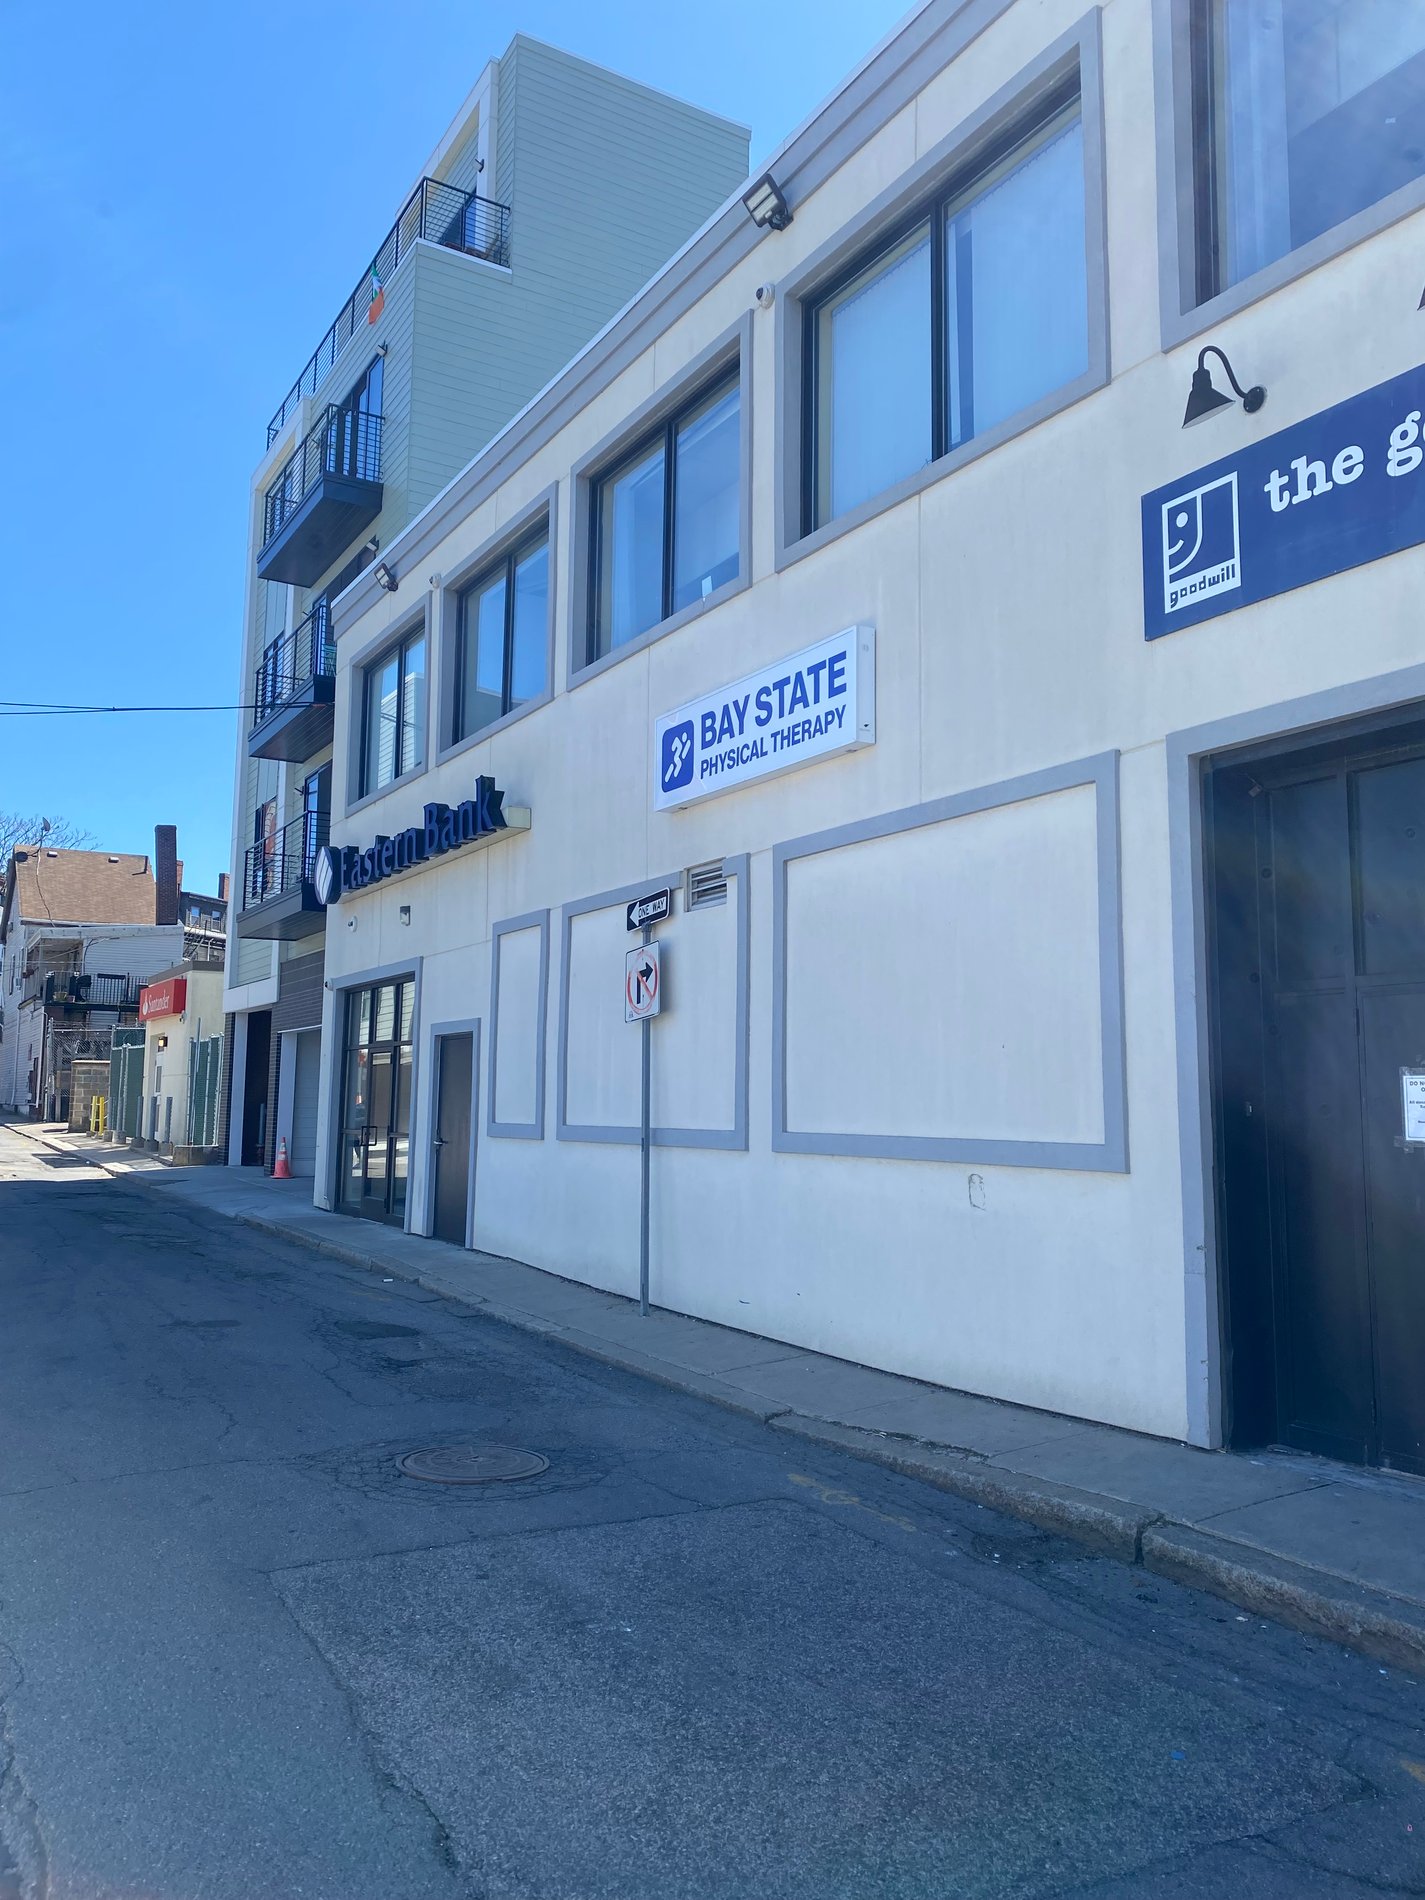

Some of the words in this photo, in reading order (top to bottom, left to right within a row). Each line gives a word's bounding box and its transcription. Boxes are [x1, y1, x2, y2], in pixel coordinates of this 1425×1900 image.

[1264, 445, 1365, 512] the
[1170, 564, 1236, 609] goodwill
[701, 693, 750, 751] BAY
[755, 650, 847, 727] STATE
[700, 737, 768, 779] PHYSICAL
[771, 704, 847, 753] THERAPY
[340, 828, 429, 894] Eastern
[423, 775, 507, 858] Bank
[638, 904, 650, 919] ONE
[652, 898, 665, 912] WAY
[148, 989, 170, 1013] Santander
